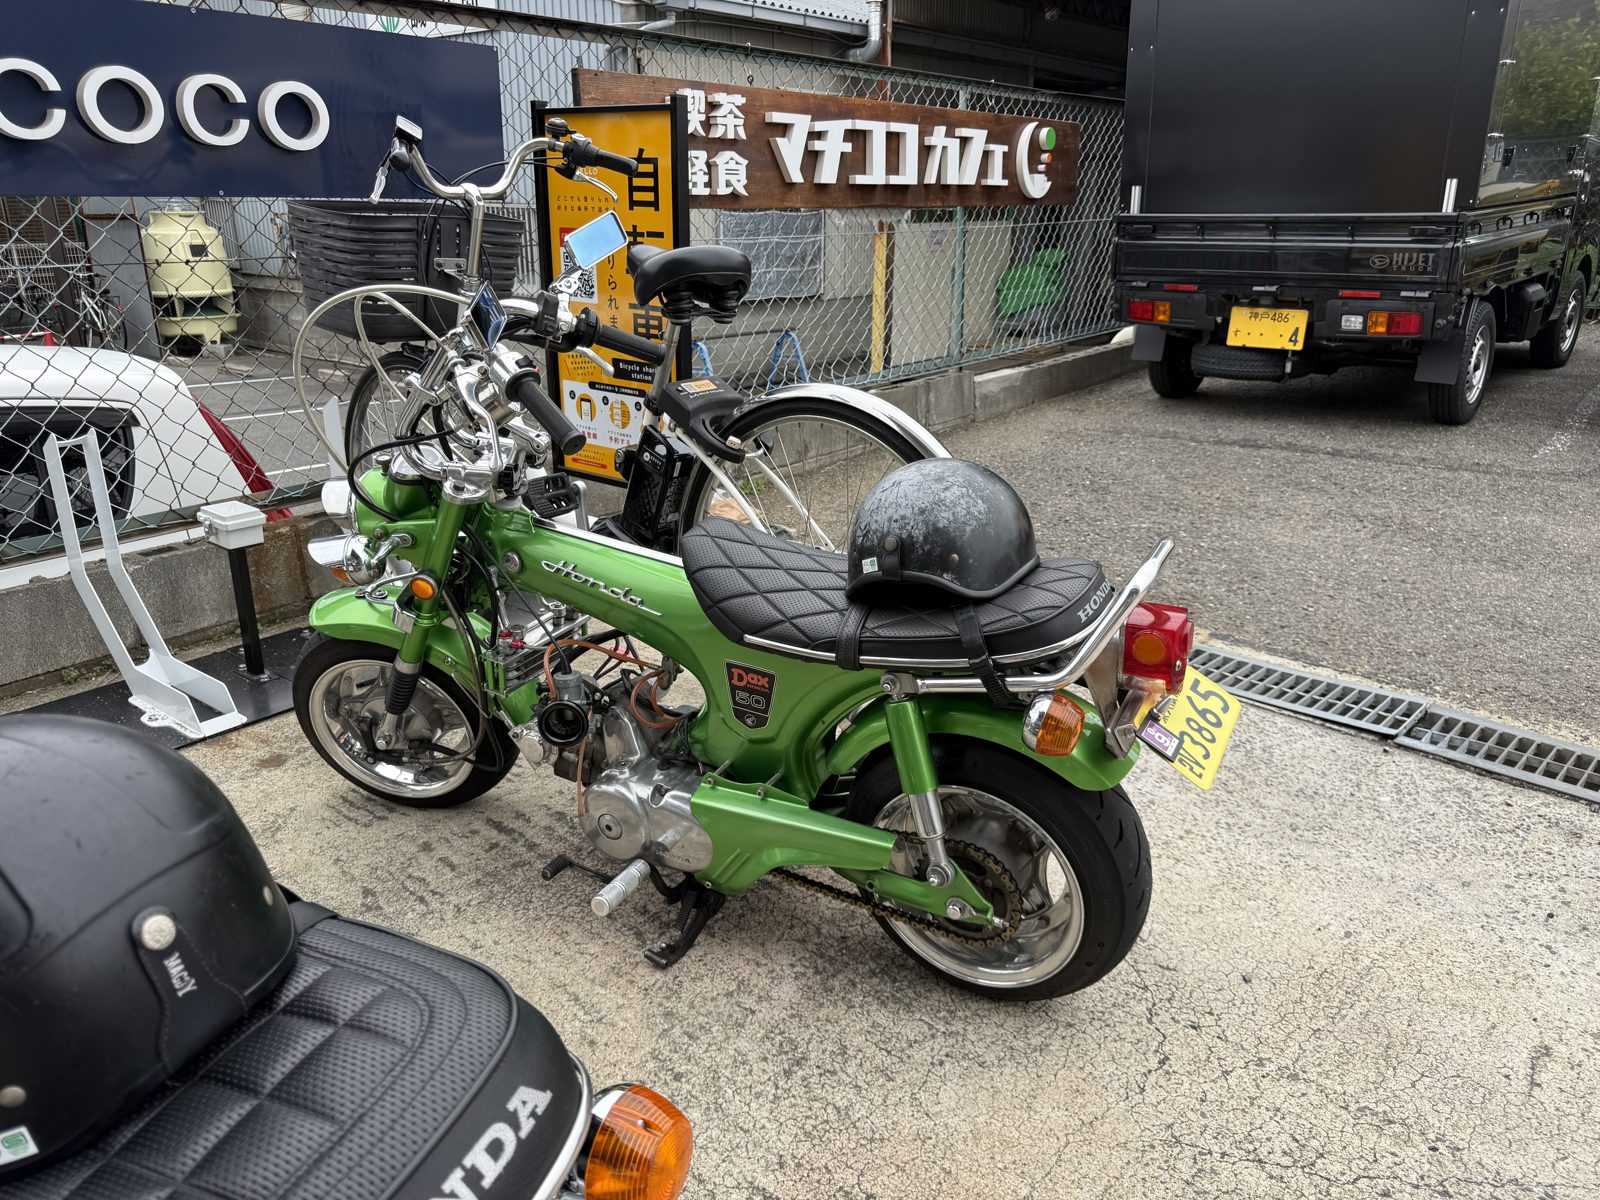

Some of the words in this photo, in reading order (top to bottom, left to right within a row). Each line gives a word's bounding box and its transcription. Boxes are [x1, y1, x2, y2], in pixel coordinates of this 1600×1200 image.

[765, 111, 1009, 186] マチココカフェ
[1392, 252, 1437, 266] HIJET
[619, 362, 640, 372] Bicycle
[631, 372, 652, 381] station
[541, 560, 663, 616] Honda
[730, 667, 769, 688] Dax
[735, 689, 766, 709] 50
